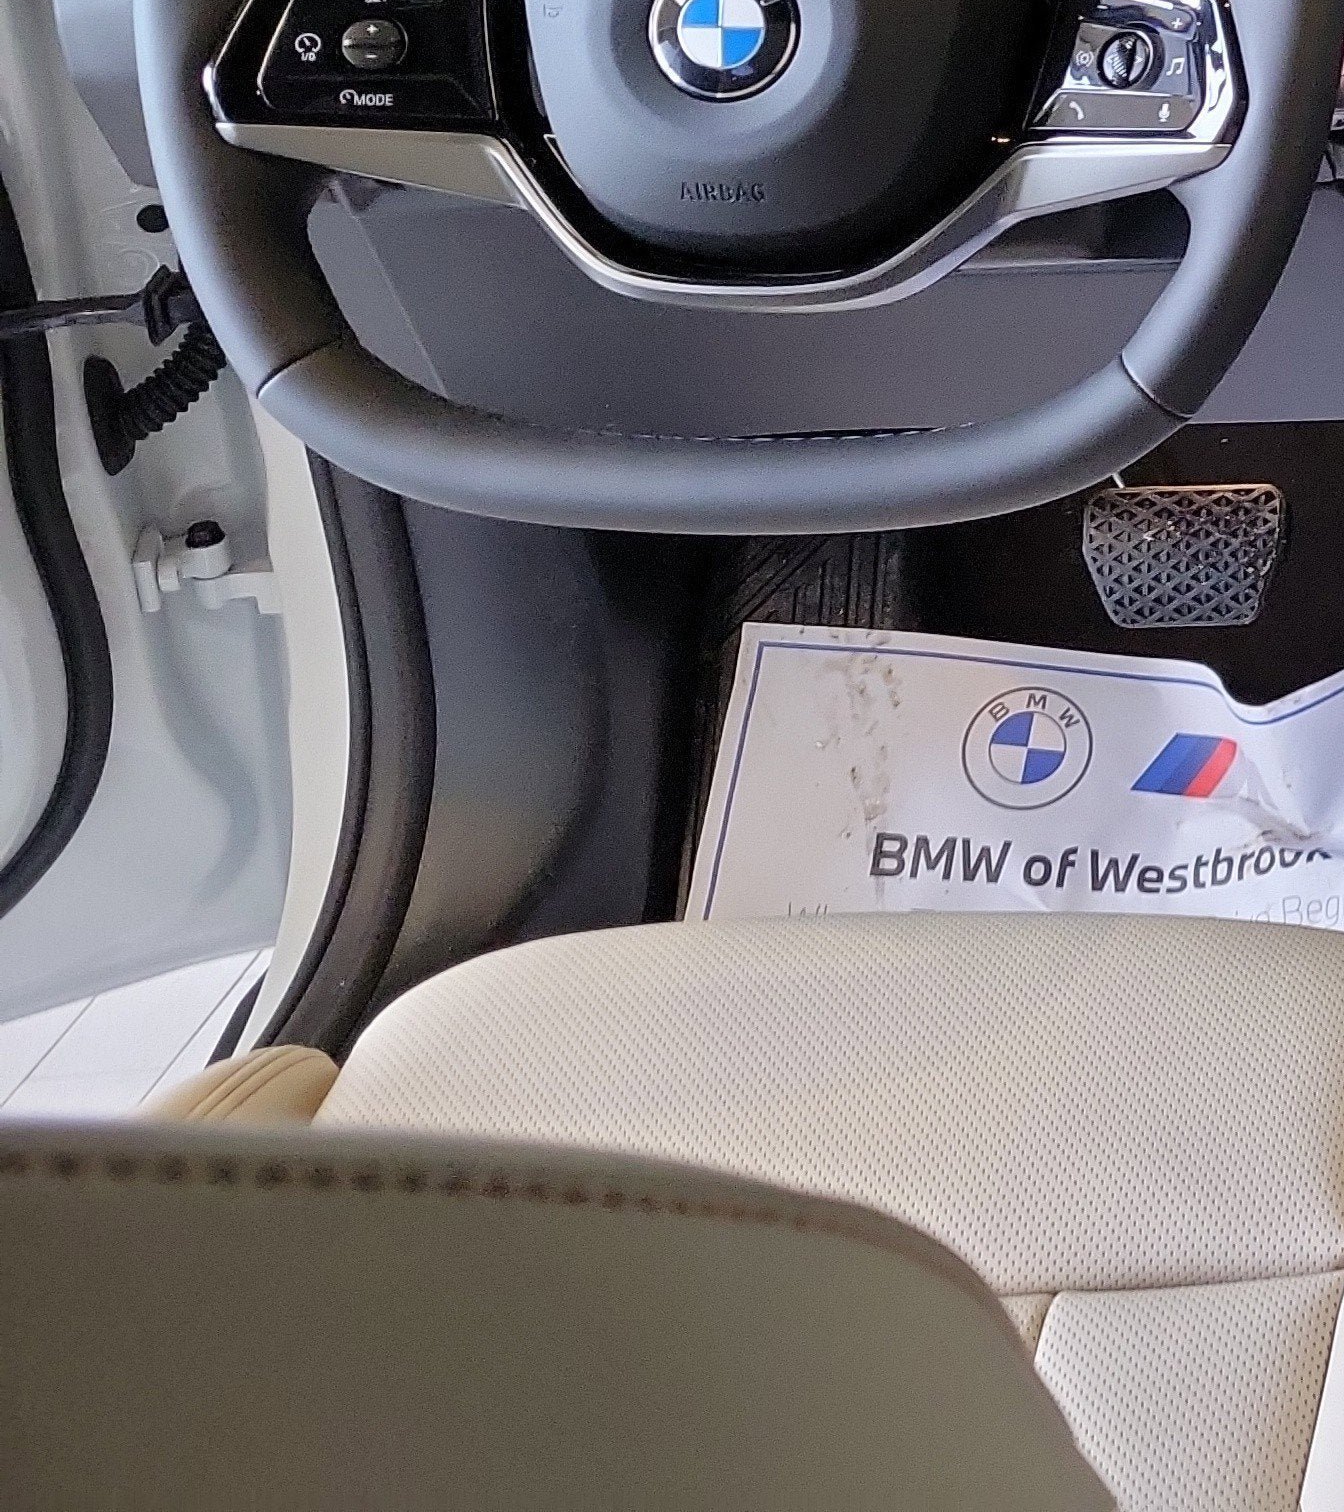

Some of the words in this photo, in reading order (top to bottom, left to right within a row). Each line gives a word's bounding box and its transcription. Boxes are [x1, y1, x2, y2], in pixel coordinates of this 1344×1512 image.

[353, 93, 394, 106] MODE
[680, 182, 765, 203] AIRBAG
[988, 692, 1081, 730] BMW
[870, 831, 1012, 884] BMW
[1022, 845, 1079, 888] of
